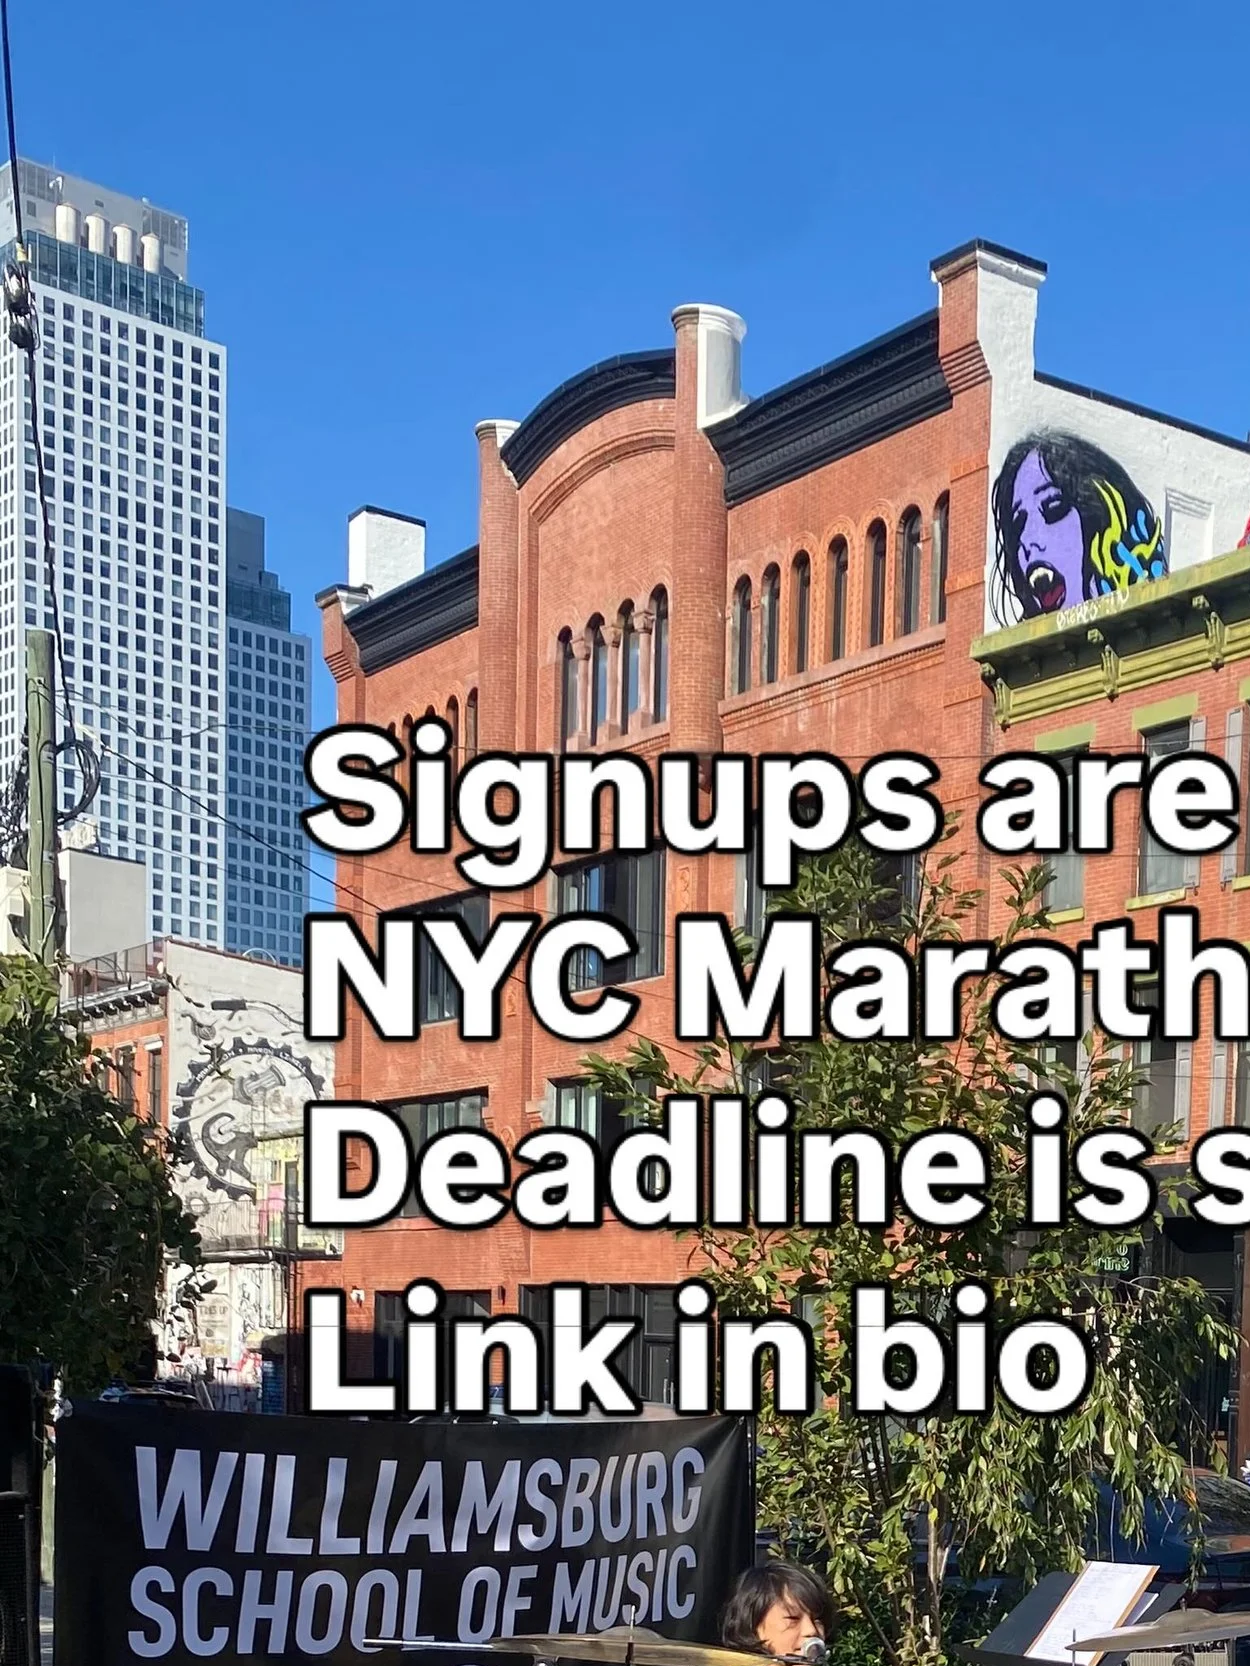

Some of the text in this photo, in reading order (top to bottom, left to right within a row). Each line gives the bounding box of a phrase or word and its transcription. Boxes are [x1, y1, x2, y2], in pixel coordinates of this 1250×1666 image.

[136, 1446, 705, 1555] WILLIAMSBURG
[128, 1545, 697, 1658] SCHOOL OF MUSIC
